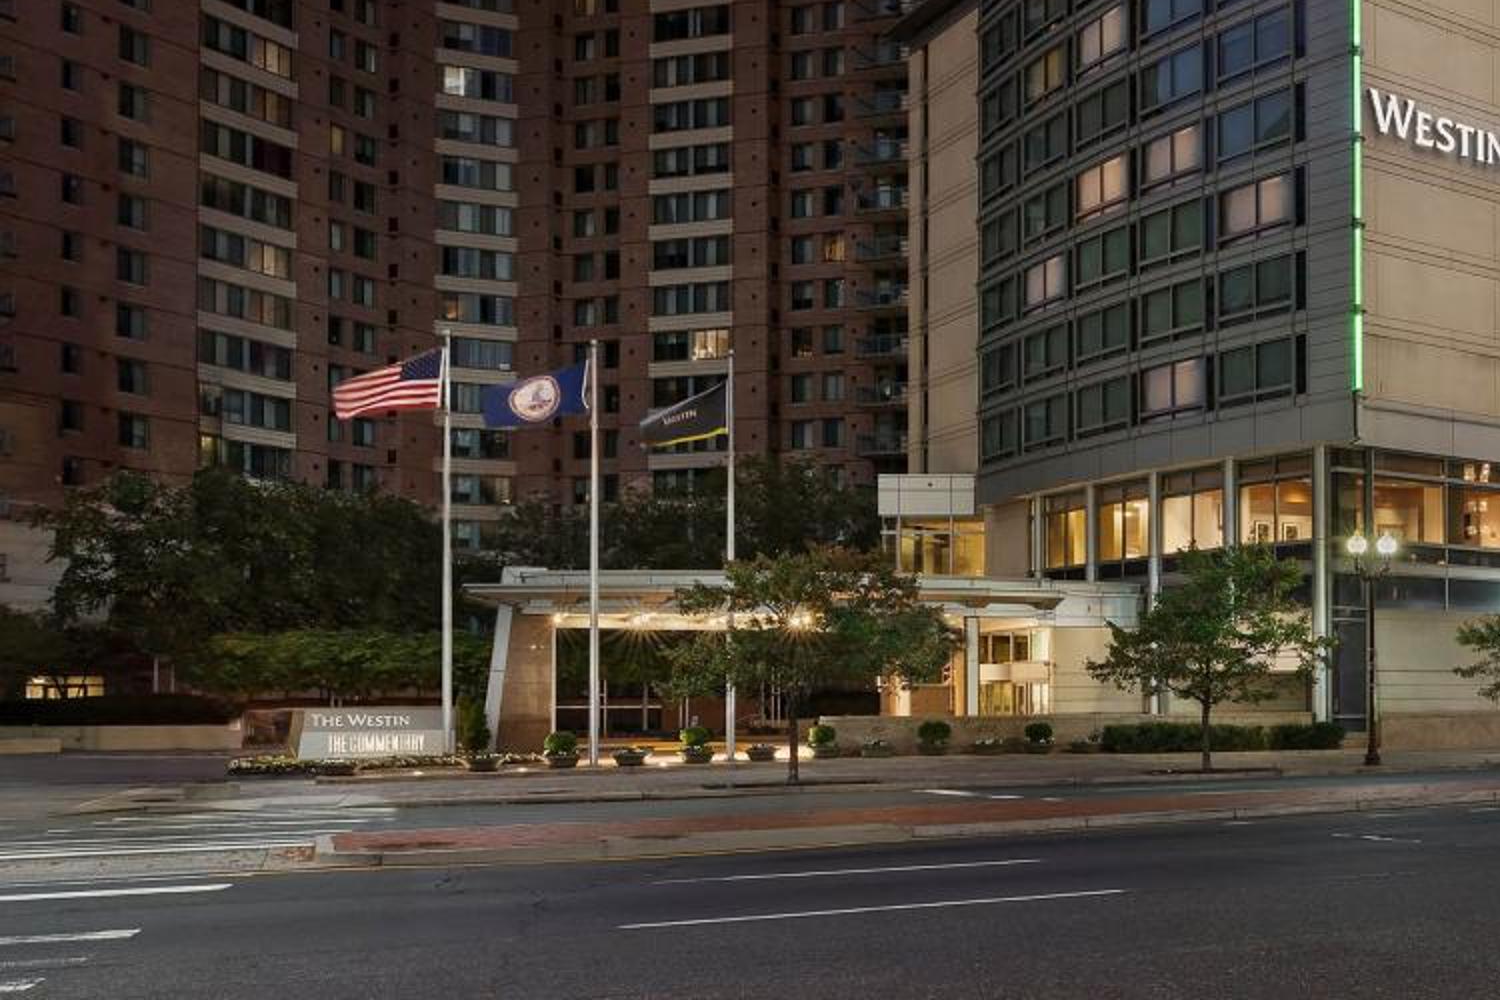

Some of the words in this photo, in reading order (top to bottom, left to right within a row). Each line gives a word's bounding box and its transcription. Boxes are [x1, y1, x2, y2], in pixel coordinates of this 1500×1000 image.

[311, 713, 344, 727] THE
[347, 713, 411, 727] WESTIN
[328, 733, 347, 753] THE
